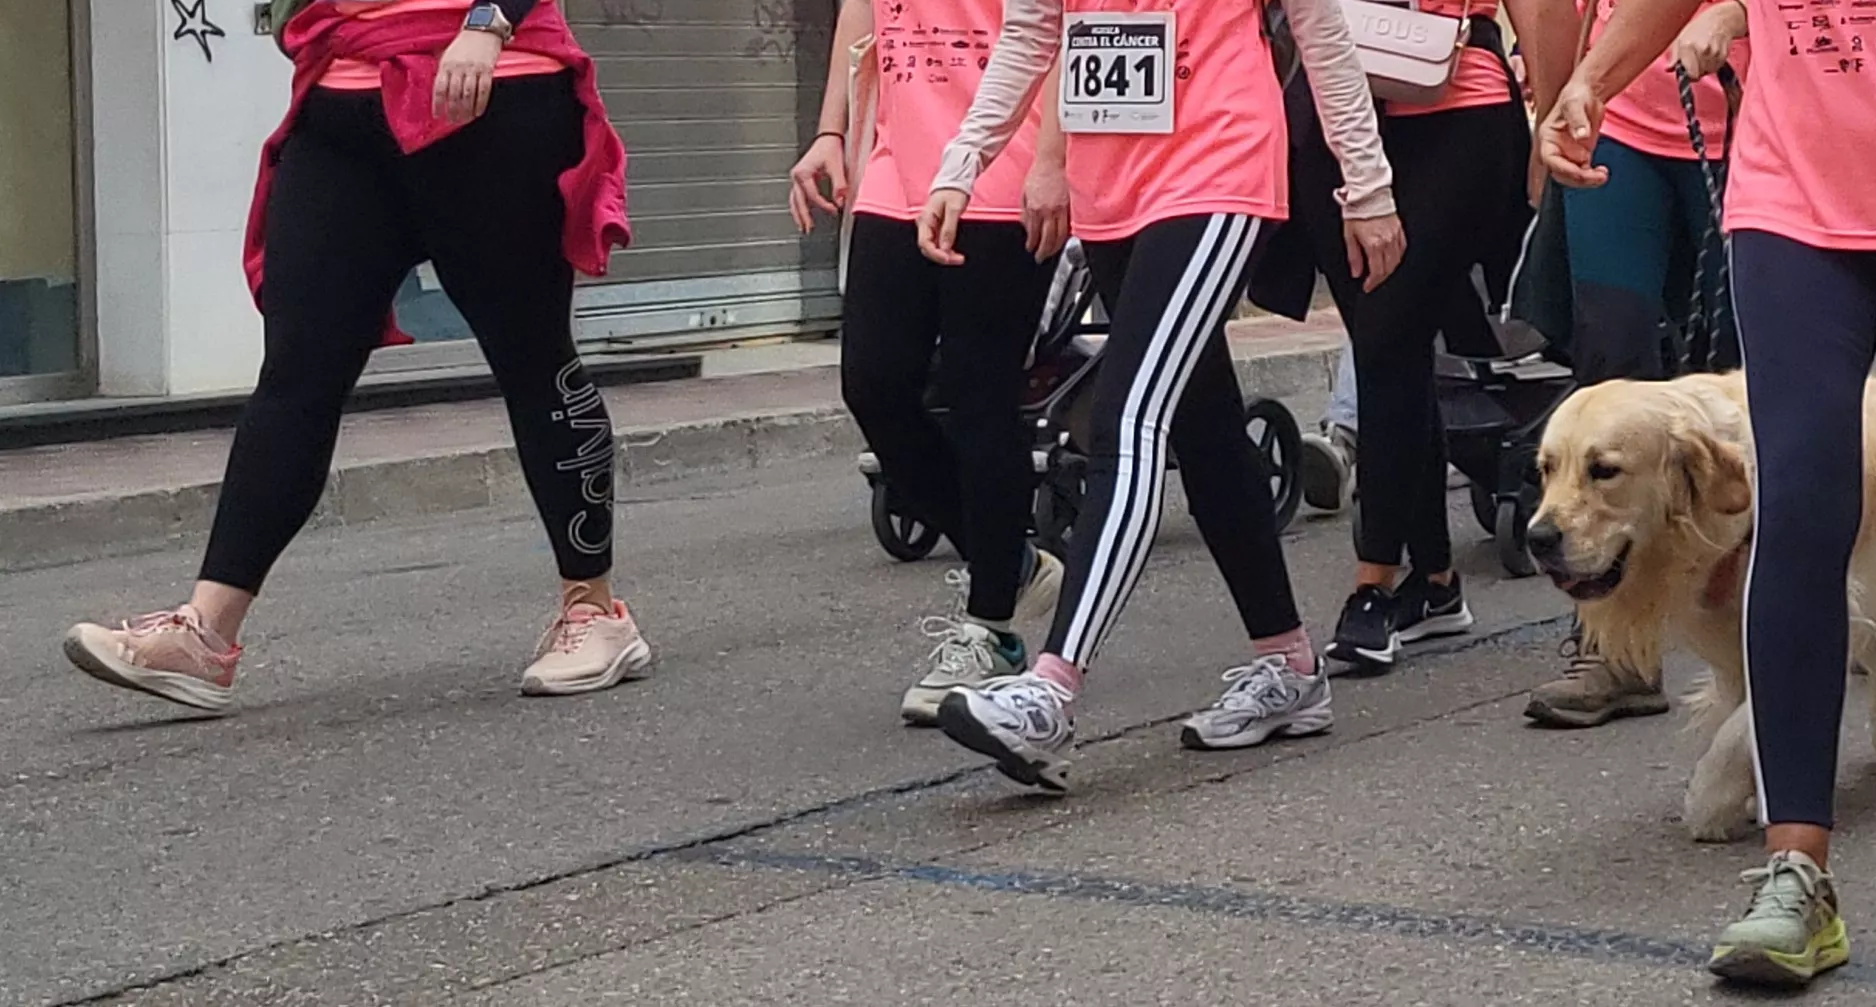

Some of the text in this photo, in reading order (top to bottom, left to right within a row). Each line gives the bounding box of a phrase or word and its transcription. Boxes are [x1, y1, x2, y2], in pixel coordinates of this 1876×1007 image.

[1113, 33, 1160, 47] CÁNCER
[1361, 13, 1429, 45] TOUS
[1069, 54, 1155, 97] 1841
